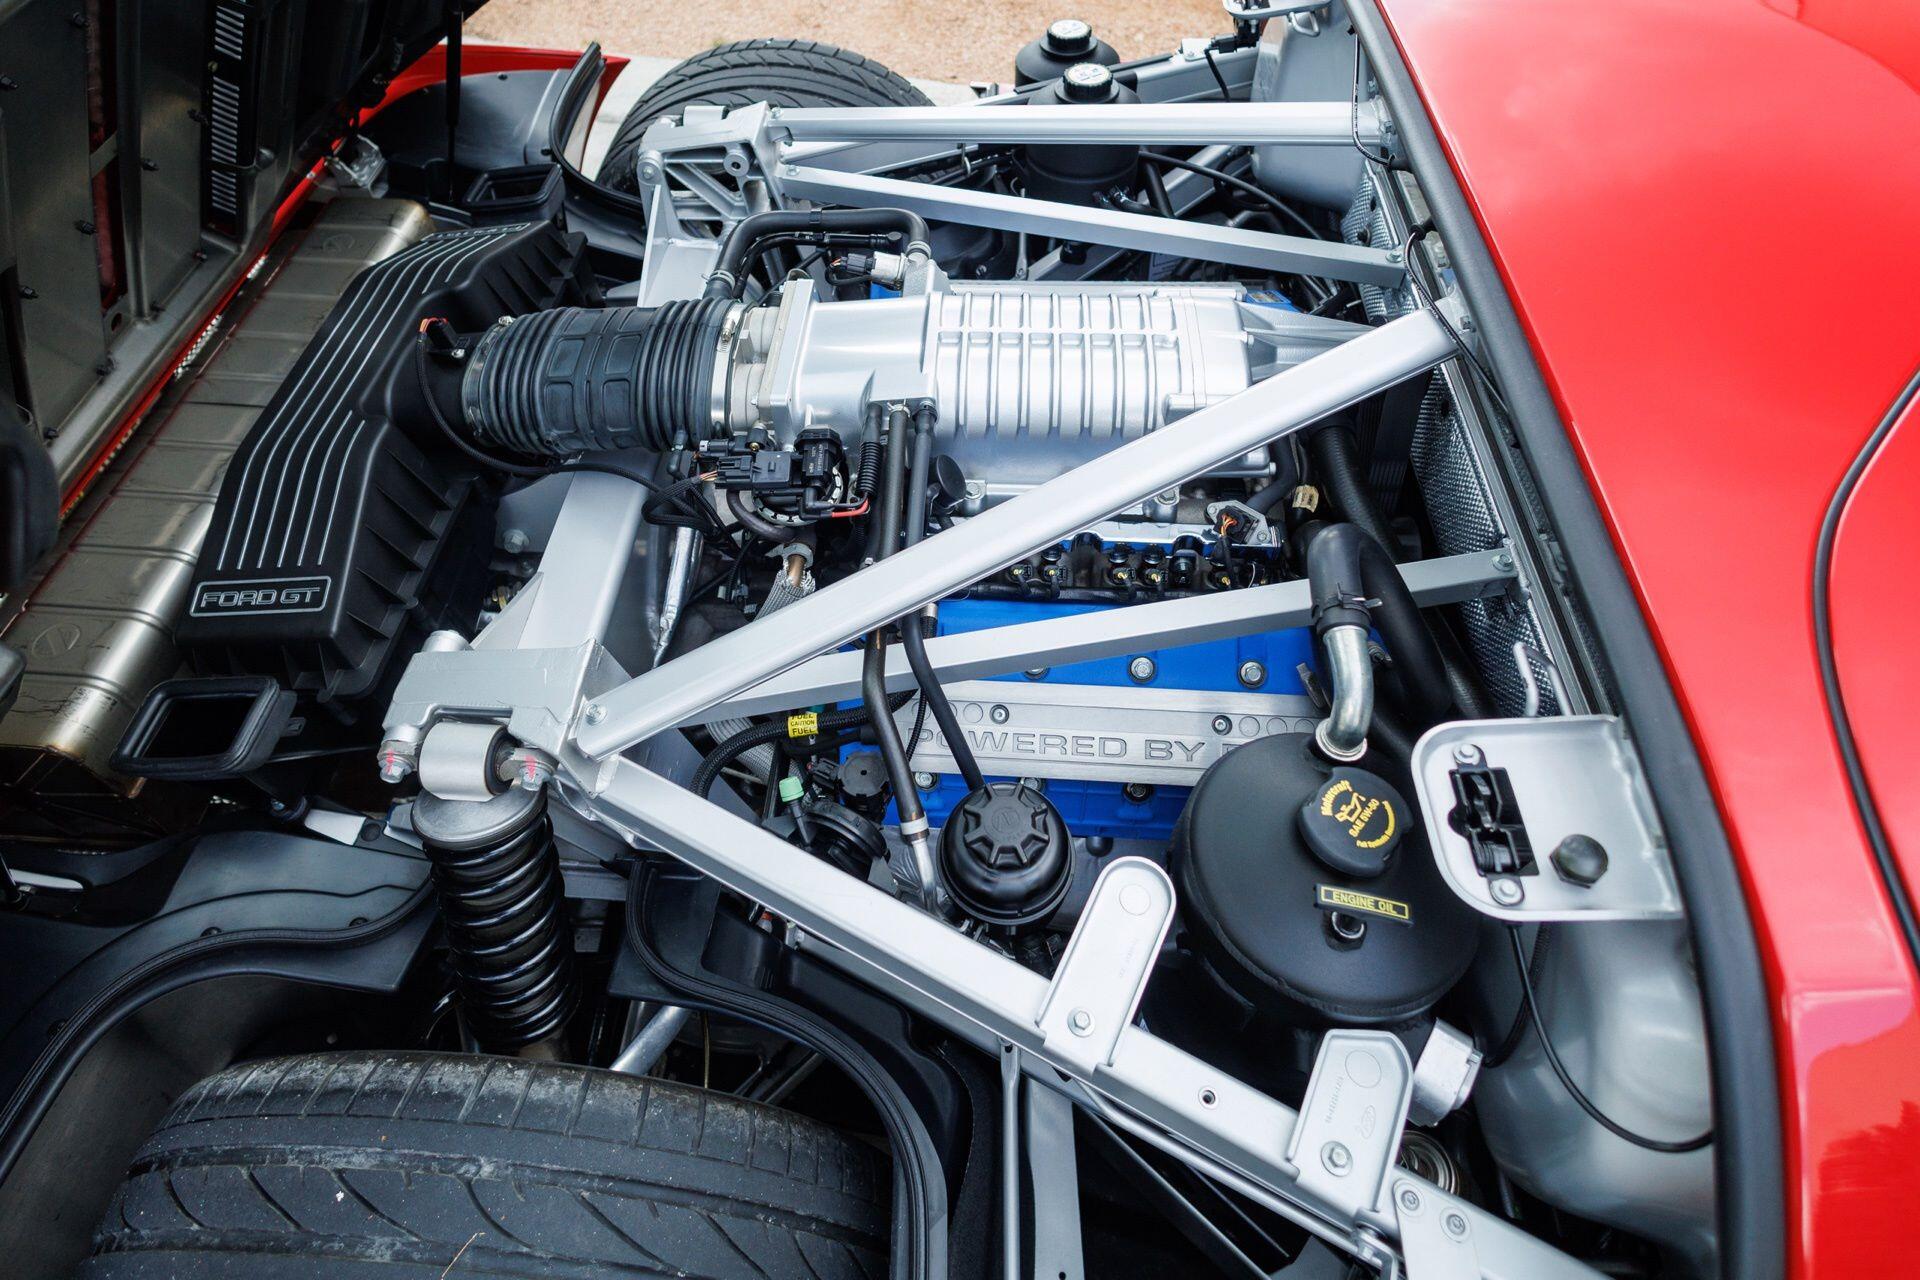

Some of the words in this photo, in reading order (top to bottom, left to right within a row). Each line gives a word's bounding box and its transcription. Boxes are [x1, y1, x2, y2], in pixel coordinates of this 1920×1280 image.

[200, 589, 277, 608] FORD
[280, 586, 321, 604] GT
[791, 719, 815, 727] CAUTION
[792, 727, 816, 736] FUEL
[1144, 739, 1206, 762] BY
[1348, 818, 1366, 838] SAE
[1332, 890, 1376, 910] ENGINE
[1378, 901, 1398, 915] OIL
